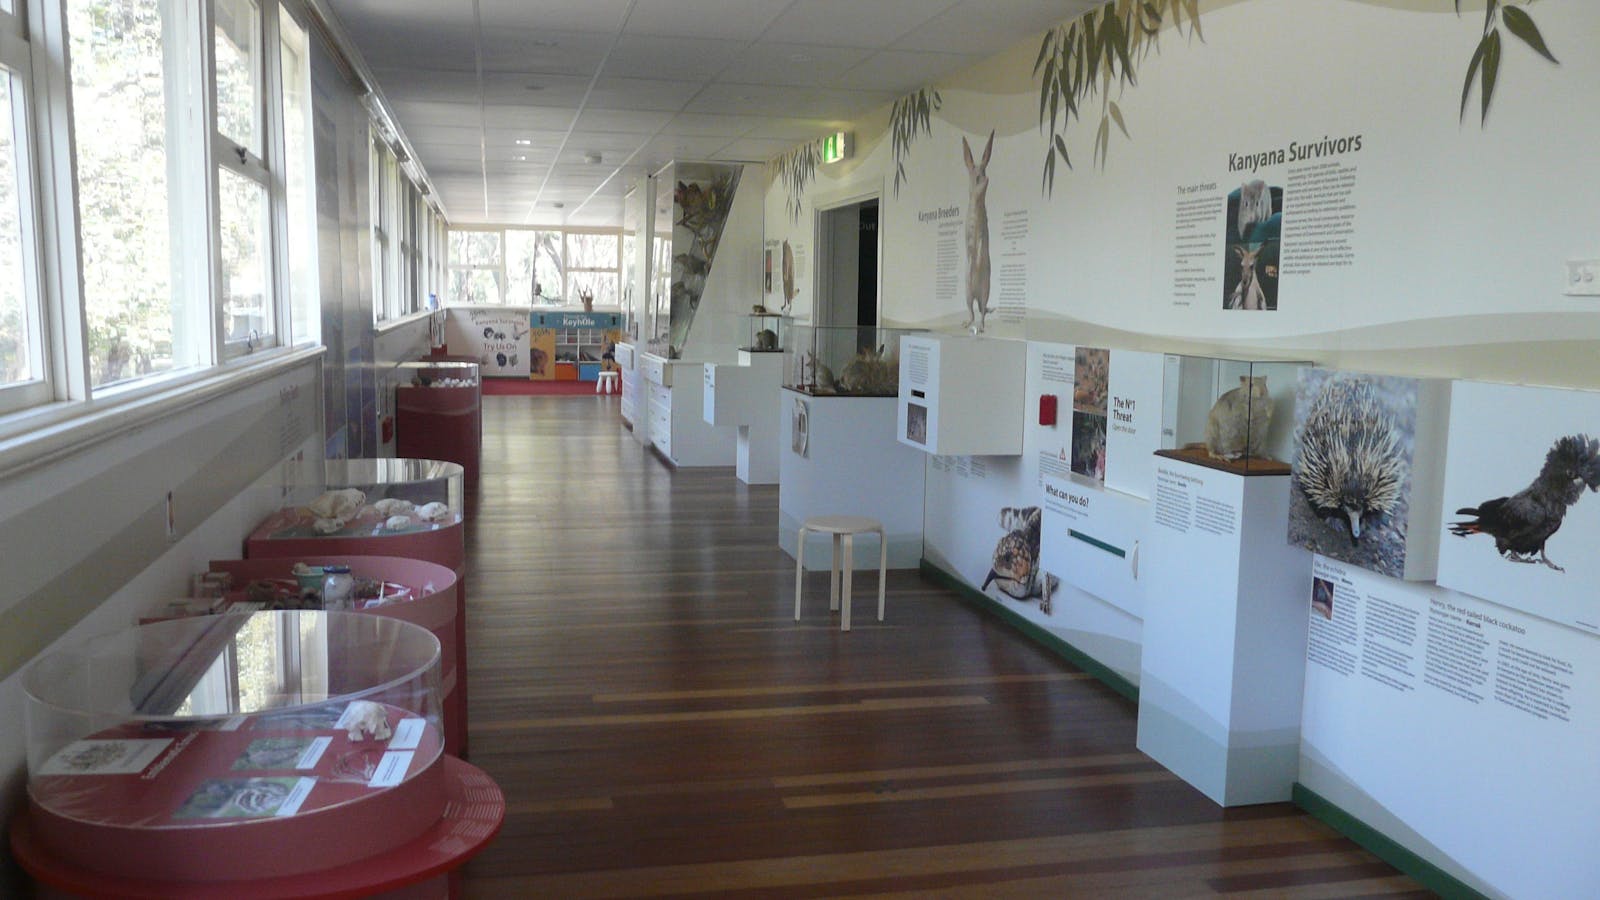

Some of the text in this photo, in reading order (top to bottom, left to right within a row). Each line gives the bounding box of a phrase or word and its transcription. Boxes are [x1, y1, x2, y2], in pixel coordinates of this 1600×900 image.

[1228, 134, 1362, 174] Kanyana Survivors
[484, 343, 517, 351] Try Us On
[1113, 396, 1124, 409] The
[1112, 409, 1132, 423] Threat
[1045, 483, 1089, 508] What can you do?
[1447, 603, 1456, 612] the
[1483, 614, 1498, 626] black
[1498, 620, 1526, 635] cockatoo
